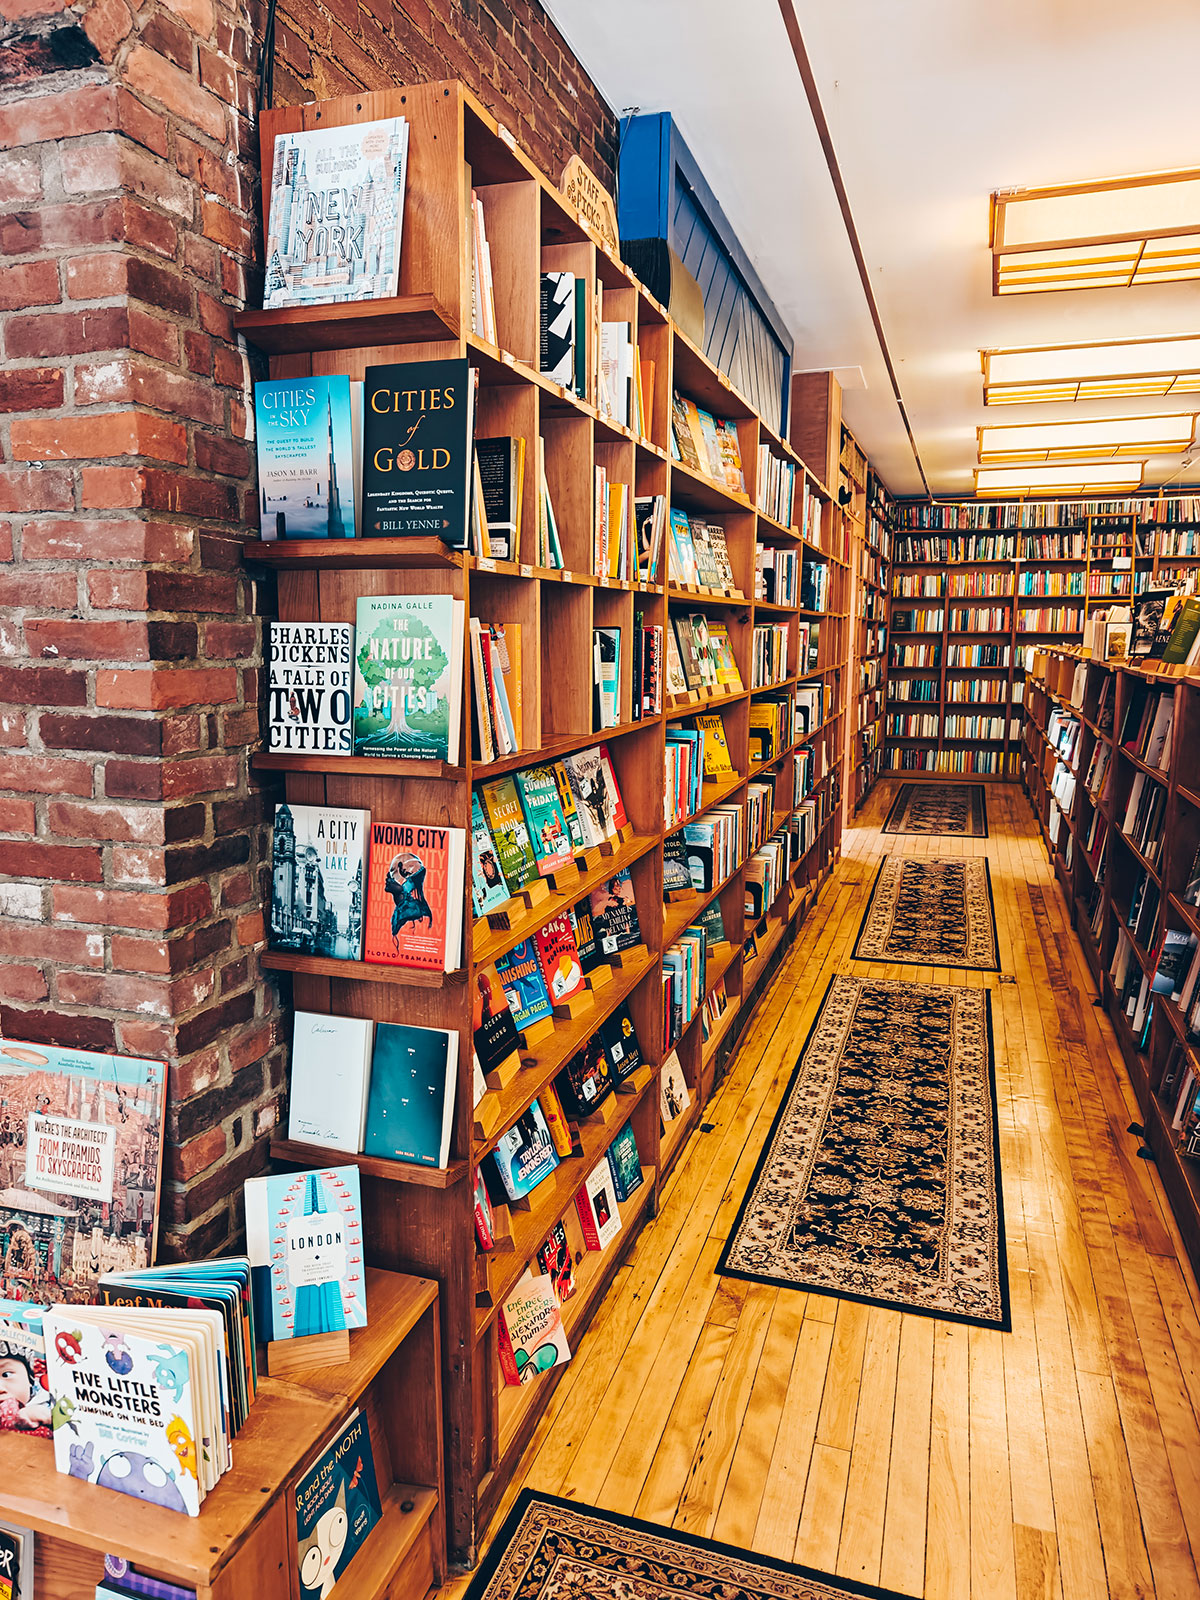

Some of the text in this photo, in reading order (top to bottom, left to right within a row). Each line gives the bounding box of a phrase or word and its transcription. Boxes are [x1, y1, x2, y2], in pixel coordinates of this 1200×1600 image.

[577, 165, 599, 204] STAFF
[306, 186, 363, 225] NEW
[577, 189, 601, 231] PICKS
[296, 225, 364, 264] YORK
[262, 388, 316, 410] CITIES
[371, 387, 456, 414] CITIES
[279, 408, 310, 428] SKY
[398, 414, 426, 447] of
[383, 519, 440, 530] BILL YENNE
[371, 602, 402, 610] NADINA
[393, 619, 408, 631] THE
[269, 628, 350, 645] CHARLES
[270, 646, 350, 663] DICKENS
[369, 637, 432, 660] NATURE
[270, 670, 350, 687] A TALE OF
[385, 667, 415, 679] OF OUR
[269, 689, 351, 725] TWO
[373, 686, 427, 709] CITIES
[269, 726, 352, 750] CITIES
[524, 776, 556, 793] SUMMER
[525, 791, 558, 808] FRIDAYS
[494, 800, 519, 820] SECRET
[317, 819, 357, 840] A CITY
[499, 817, 519, 834] BOOK
[373, 825, 446, 849] WOMB CITY
[326, 840, 348, 855] ON A
[325, 856, 347, 871] LAKE
[544, 936, 558, 953] MARK
[367, 950, 443, 965] TLOTLO TSAMAASE
[500, 959, 537, 986] ANISHING
[531, 1000, 549, 1015] PAGER
[484, 1013, 502, 1031] OCEAN
[488, 1026, 507, 1044] VUONG
[34, 1120, 108, 1144] WHERE'S THE ARCHITECT?
[38, 1137, 101, 1164] FROM PYRAMIDS
[520, 1140, 544, 1164] TAYLOR
[36, 1154, 102, 1183] TO SKYSCRAPERS
[475, 1211, 483, 1229] CLAIRE
[291, 1232, 341, 1250] LONDON
[544, 1228, 564, 1259] FLIES
[102, 1290, 142, 1308] Leaf
[72, 1370, 159, 1399] FIVE LITTLE
[75, 1386, 161, 1416] MONSTERS
[79, 1404, 164, 1428] JUMPING ON THE BED
[304, 1423, 362, 1501] and the MOTH
[307, 1492, 320, 1511] BOOK
[315, 1496, 325, 1513] AND
